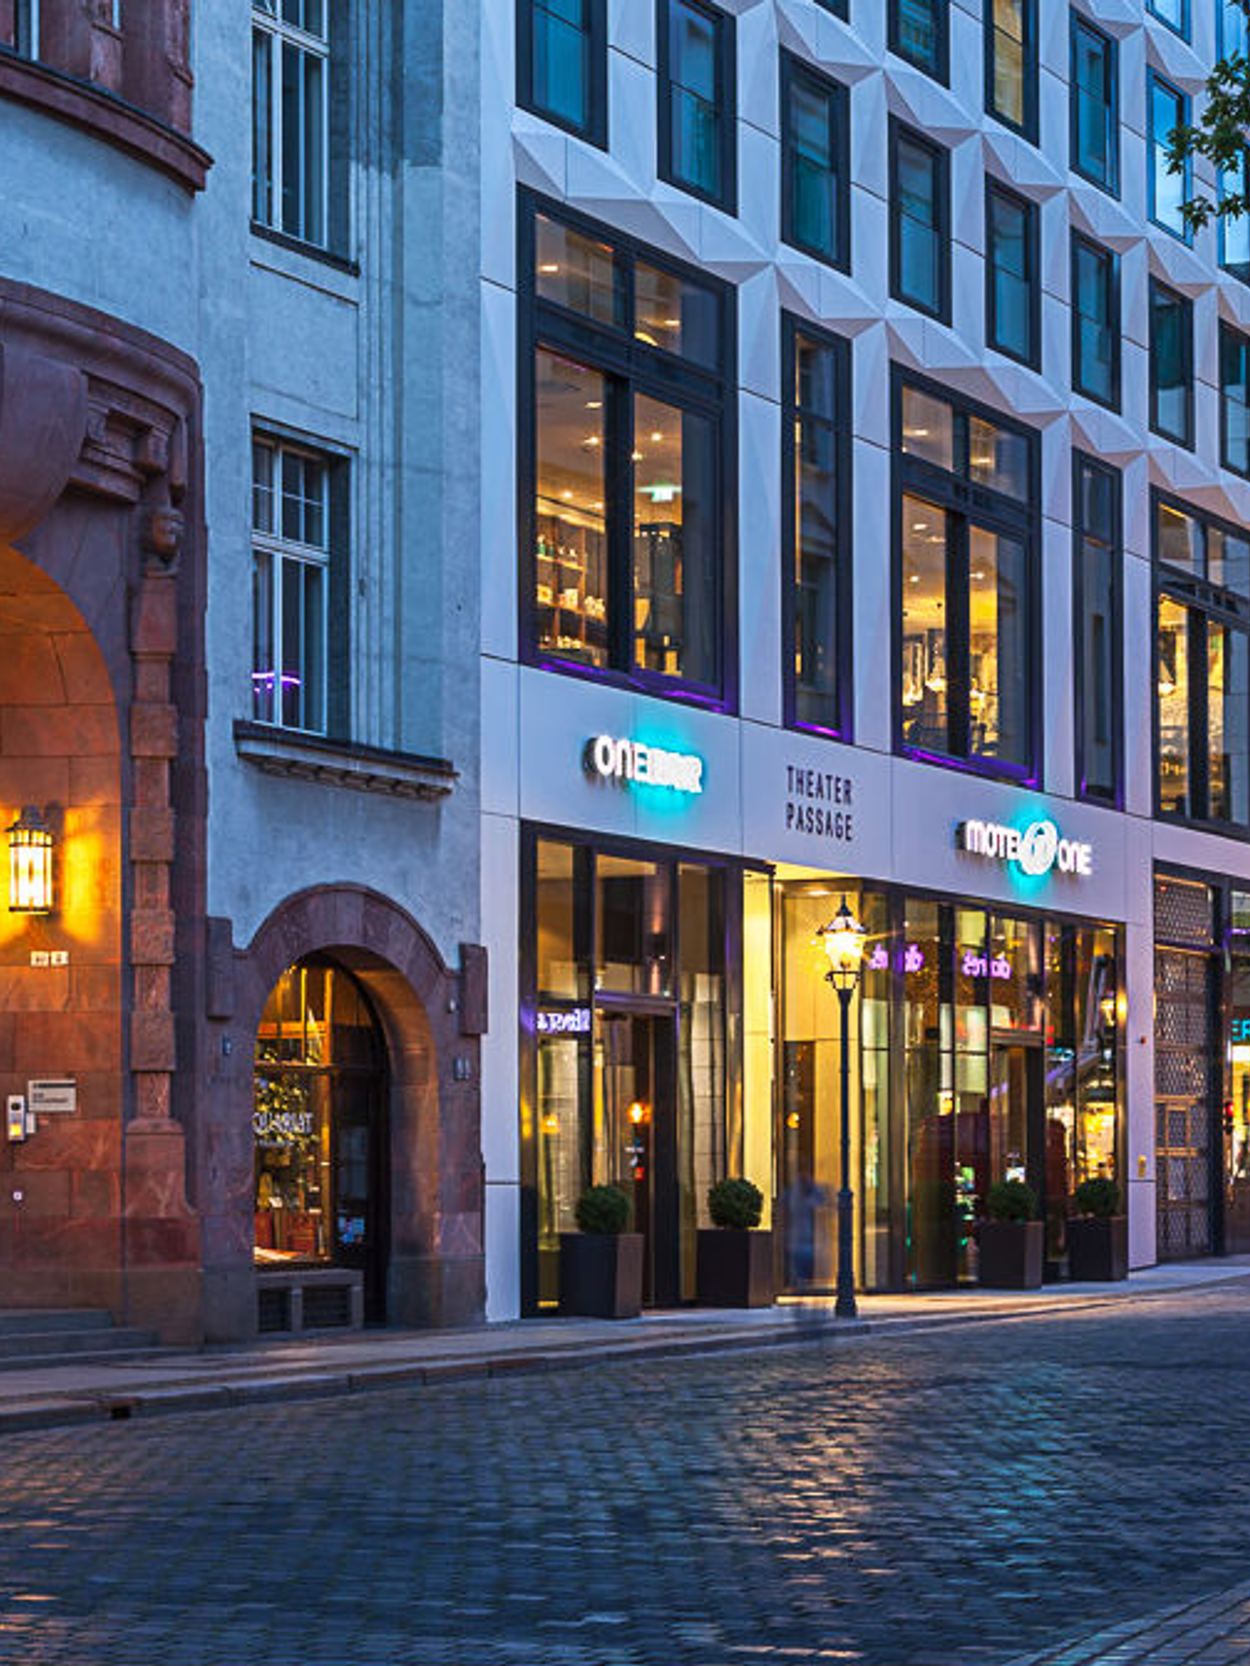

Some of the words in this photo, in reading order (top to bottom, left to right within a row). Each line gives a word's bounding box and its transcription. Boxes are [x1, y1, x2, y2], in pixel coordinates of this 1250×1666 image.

[786, 764, 853, 806] THEATER
[786, 801, 853, 842] PASSAGE
[1057, 839, 1093, 875] ONE
